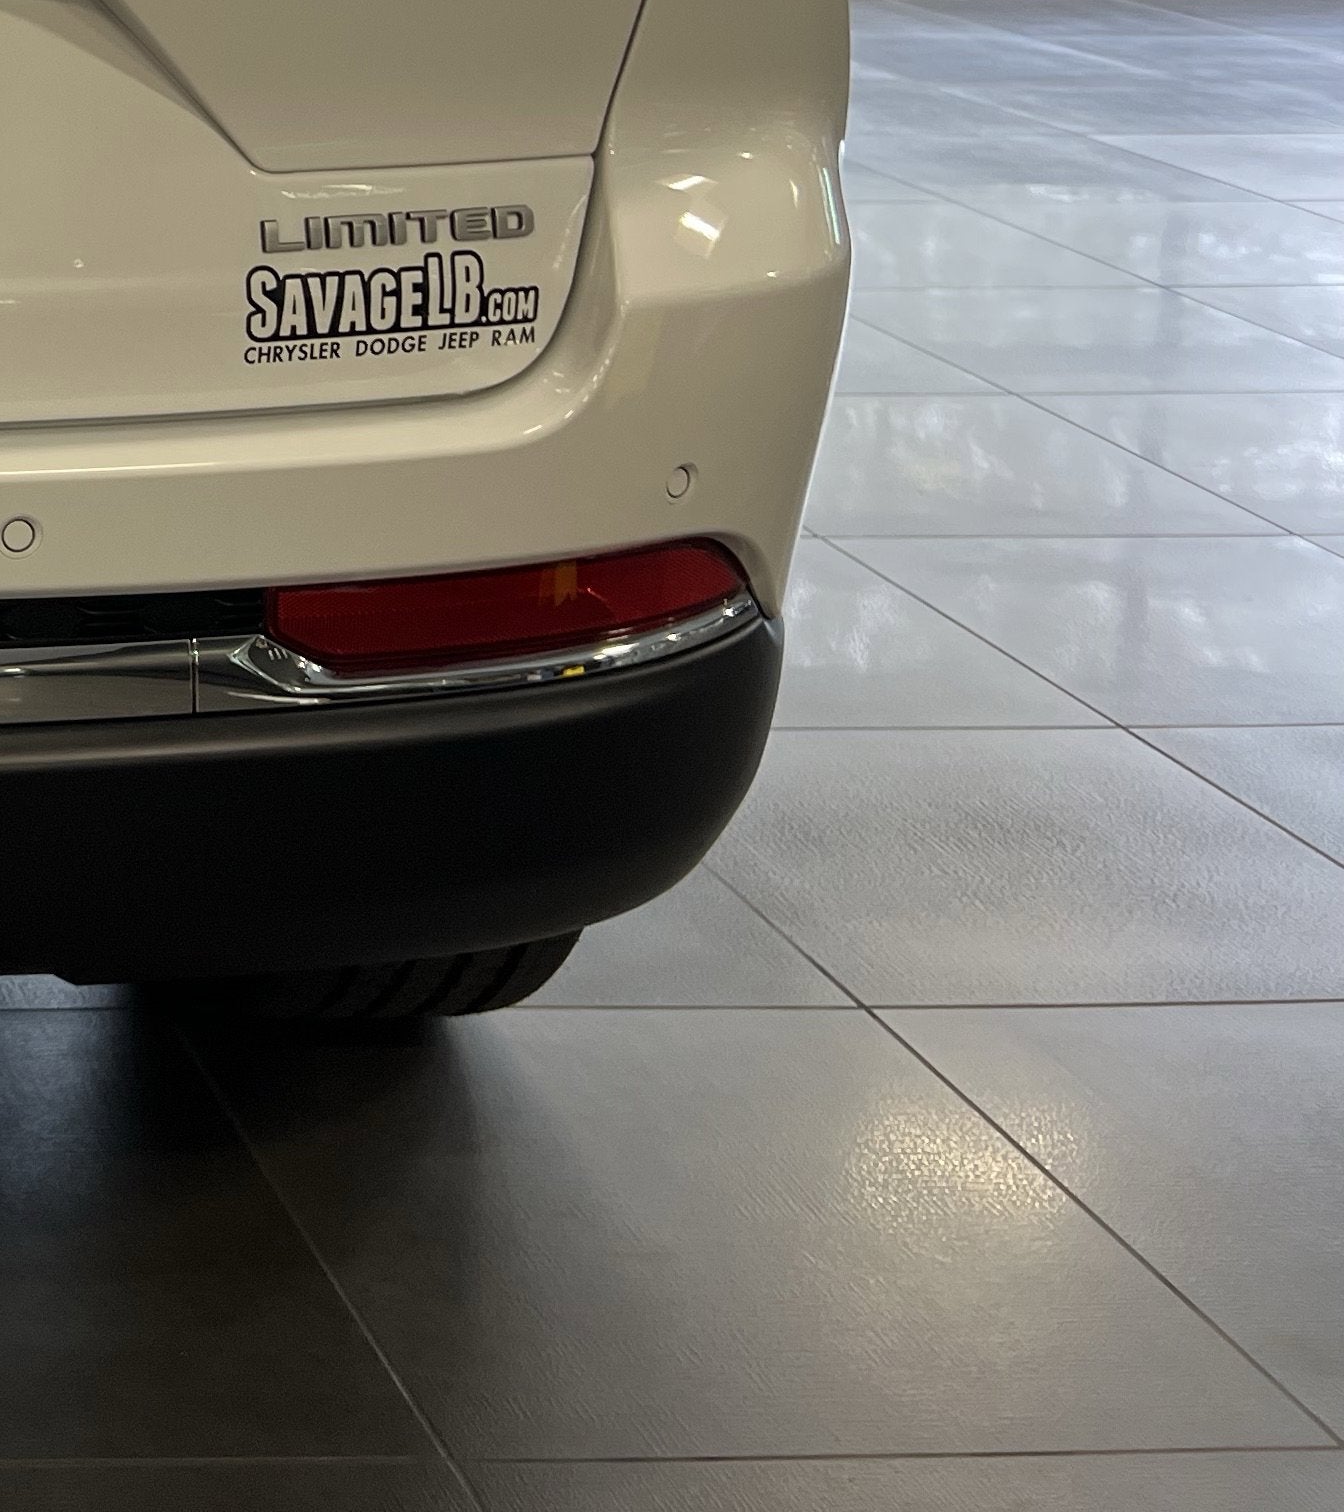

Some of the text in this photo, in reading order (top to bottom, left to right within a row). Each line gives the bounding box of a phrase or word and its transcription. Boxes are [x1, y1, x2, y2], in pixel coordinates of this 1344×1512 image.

[260, 204, 535, 254] LIMITED
[244, 326, 536, 365] CHRYSLER DODGE JEEP RAM
